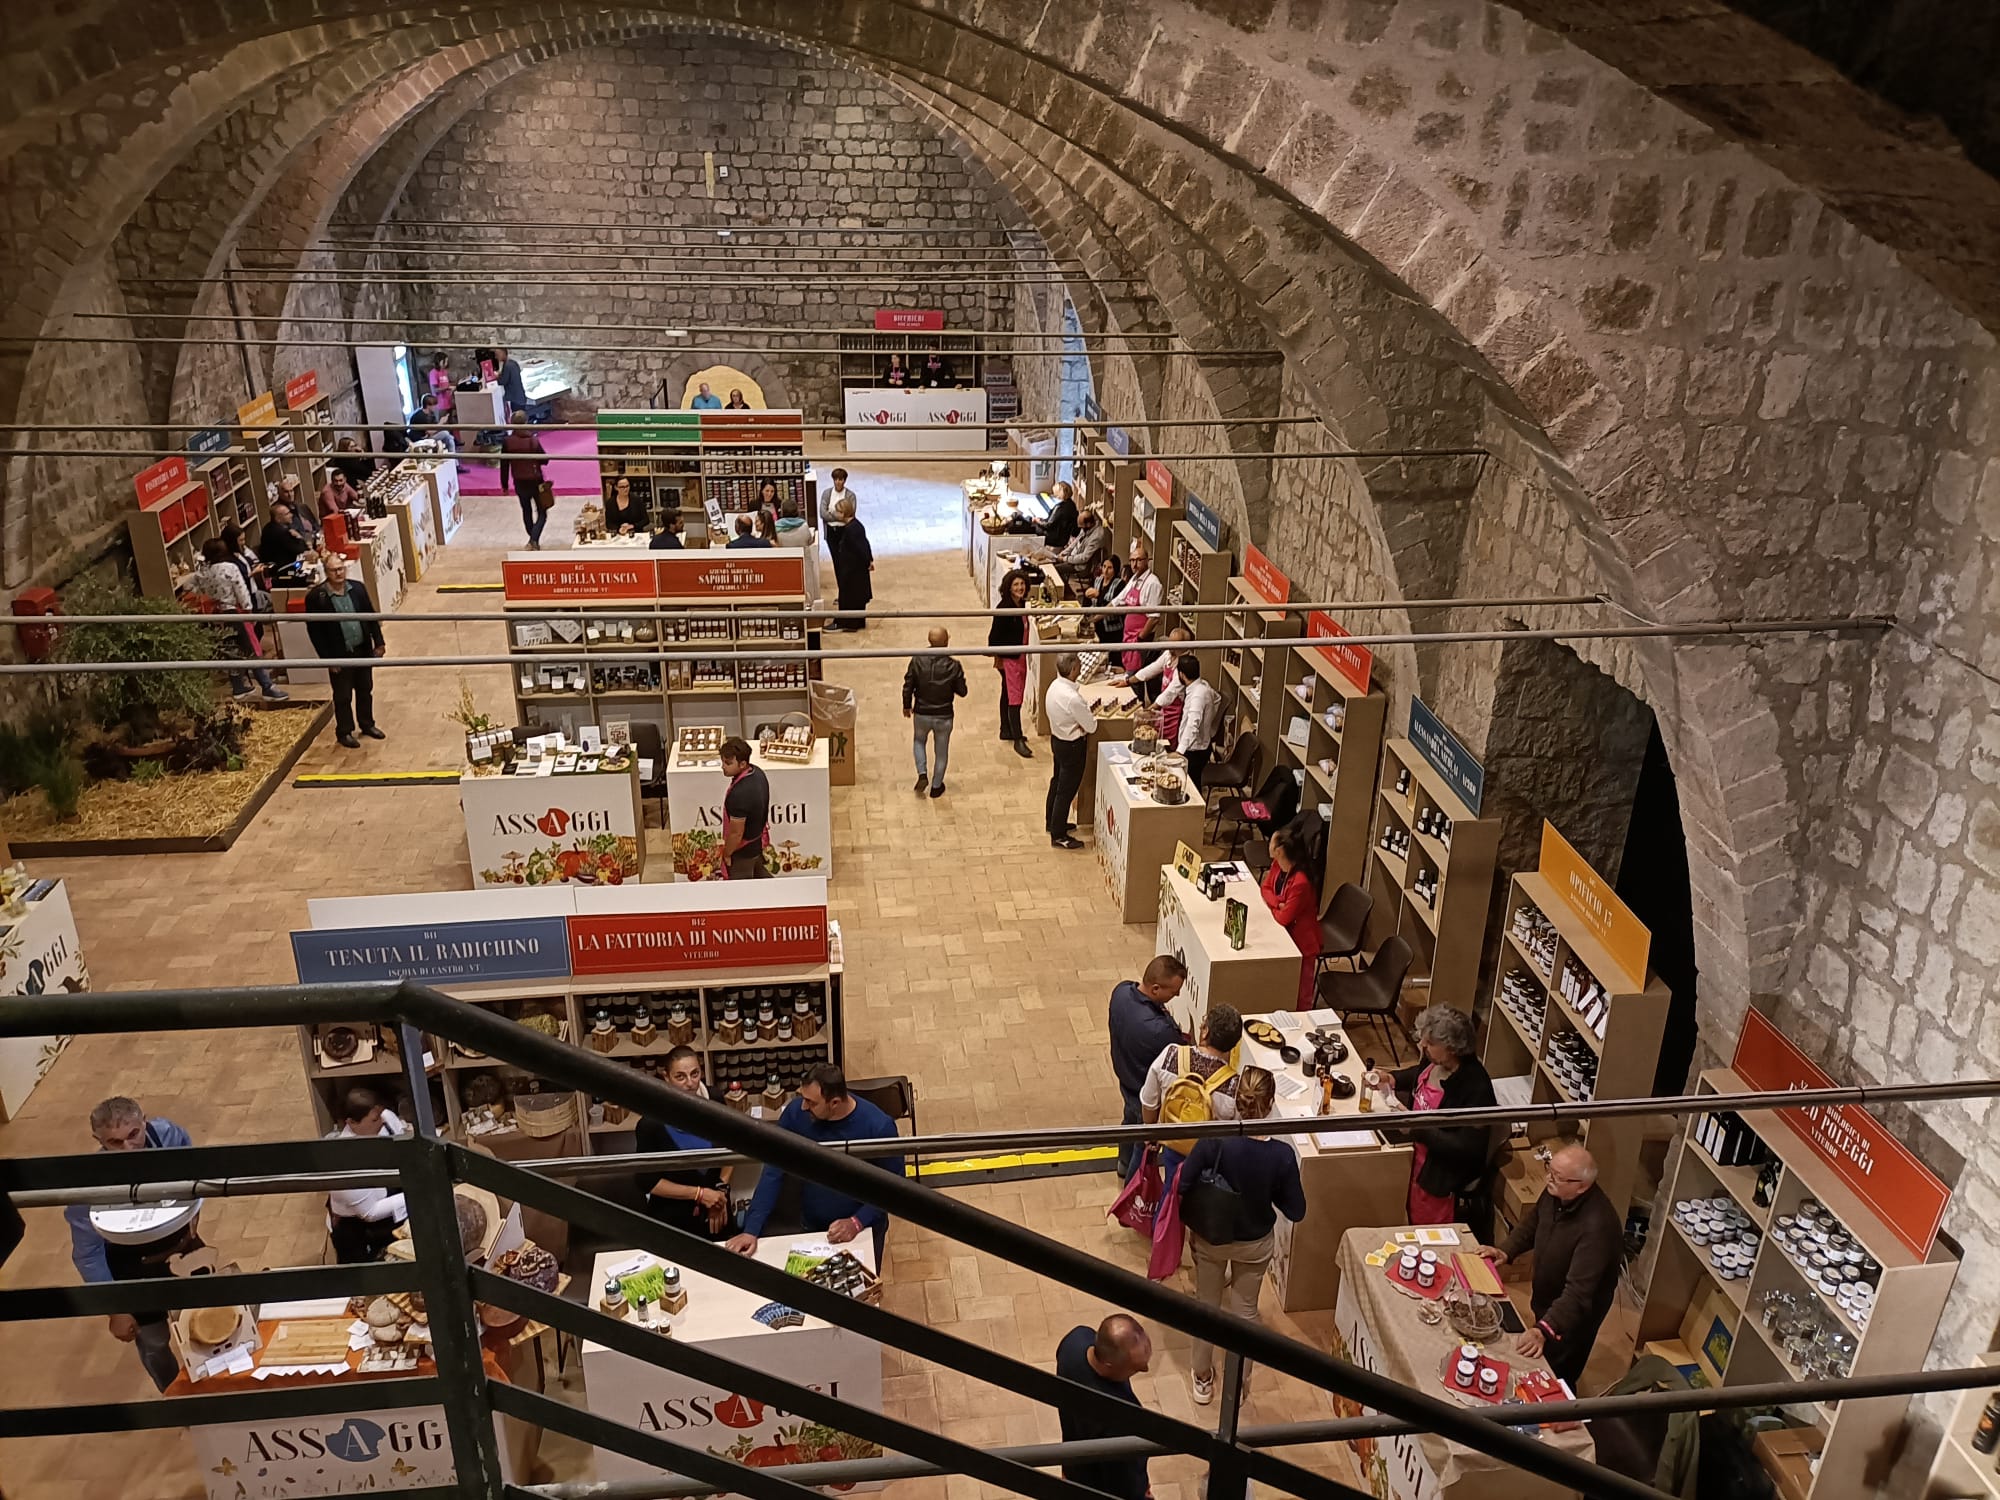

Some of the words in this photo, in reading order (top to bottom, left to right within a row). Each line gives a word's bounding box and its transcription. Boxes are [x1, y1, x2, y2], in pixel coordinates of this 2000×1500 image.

[858, 411, 907, 424] ASSAGGI
[928, 411, 977, 424] ASSAGGI
[522, 573, 557, 585] PERLE
[560, 573, 596, 584] DELLA
[598, 572, 638, 584] TUSCIA
[698, 575, 730, 584] SAPORI
[733, 574, 743, 583] DI
[745, 573, 764, 583] IERI
[492, 810, 611, 836] ASSAGGI
[694, 803, 808, 828] ASGGI
[1569, 870, 1602, 916] OPIFICIO
[577, 934, 600, 951] LA
[605, 931, 685, 950] FATTORIA
[689, 930, 706, 946] DI
[712, 927, 767, 945] NONNO
[772, 924, 821, 943] FIORE
[325, 946, 403, 967] TENUTA
[409, 944, 430, 962] IL
[436, 936, 540, 961] RADICHINO
[683, 951, 720, 960] VITERBO
[419, 966, 429, 975] DI
[431, 964, 464, 975] CASTRO
[1825, 1106, 1861, 1146] BIOLOGICA
[1861, 1138, 1871, 1152] DI
[1810, 1126, 1838, 1159] VITERBO
[1820, 1112, 1875, 1176] POLEGGI
[244, 1419, 444, 1464] ASSAGG
